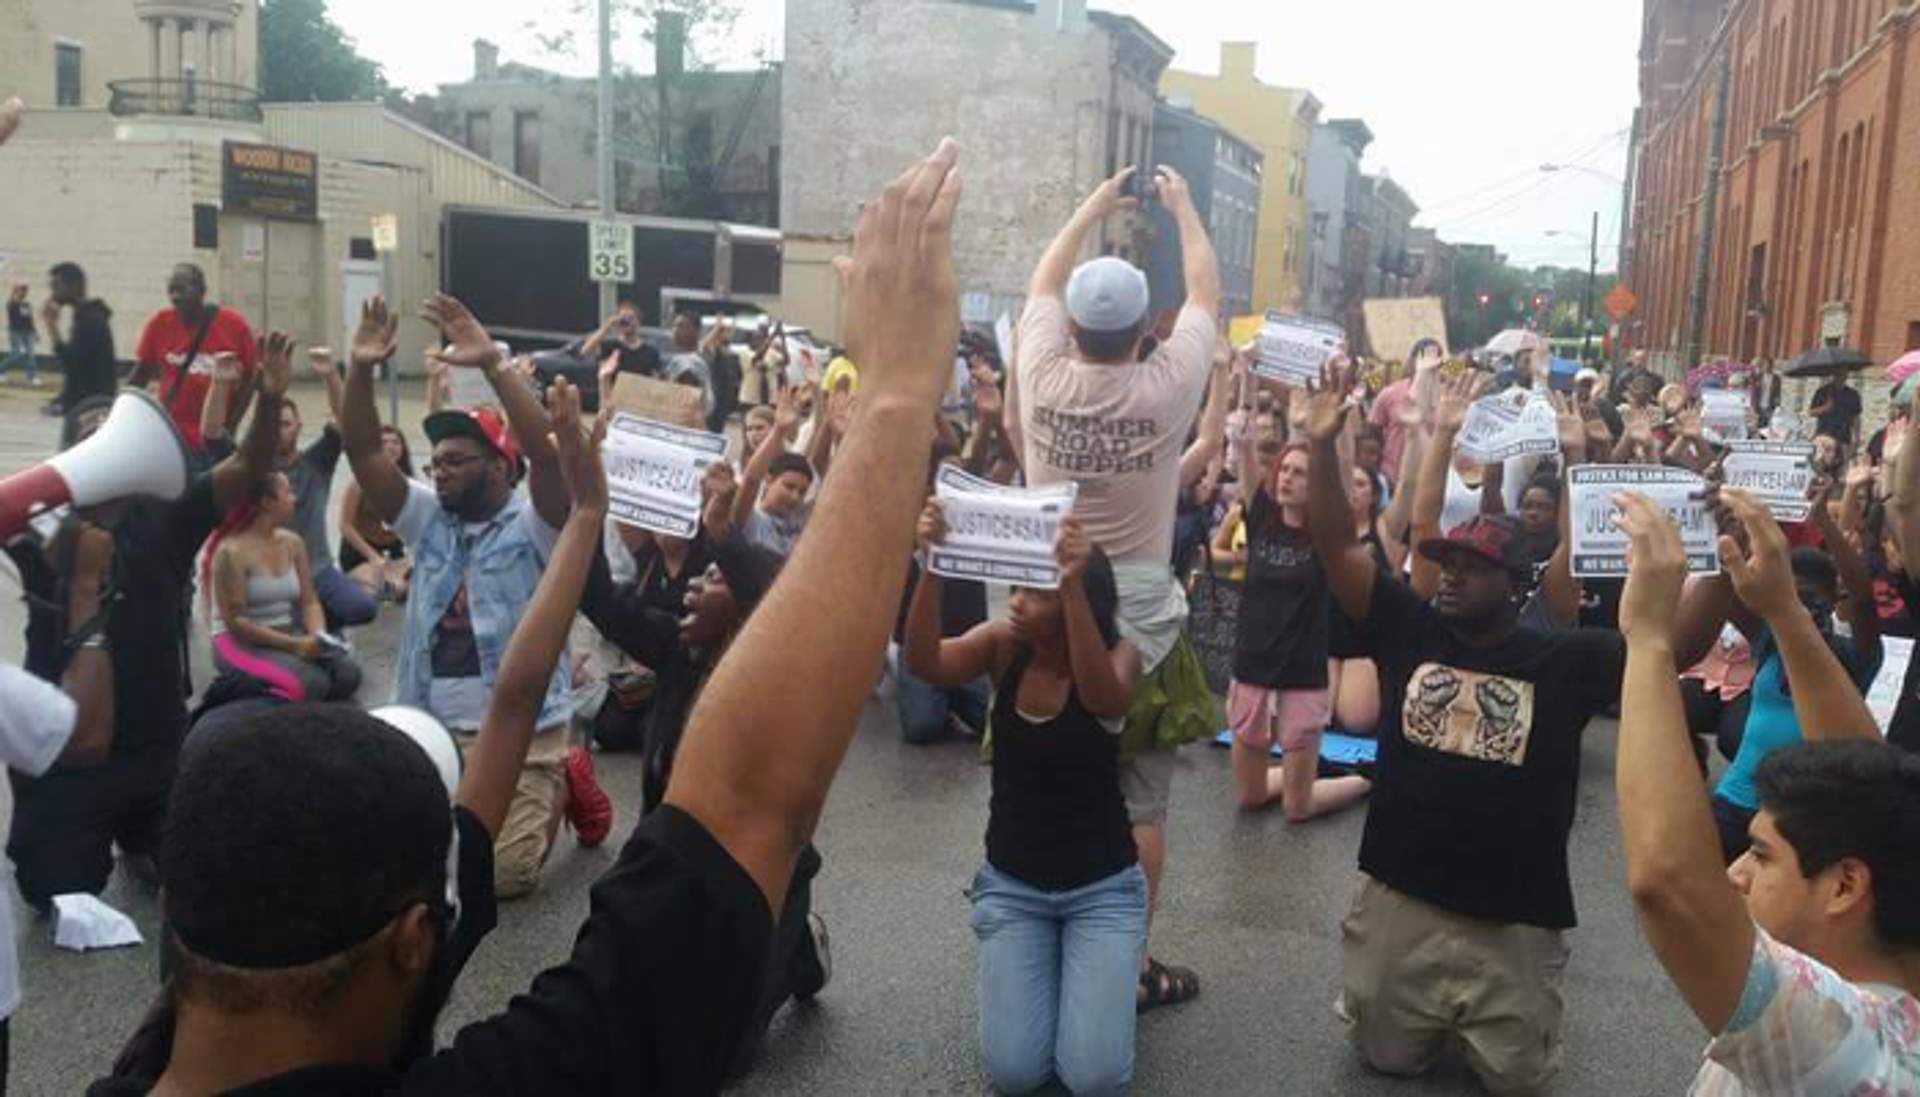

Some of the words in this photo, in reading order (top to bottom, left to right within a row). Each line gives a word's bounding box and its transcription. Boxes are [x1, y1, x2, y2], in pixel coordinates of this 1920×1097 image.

[595, 225, 627, 237] SPEED
[595, 252, 629, 277] 35
[1033, 406, 1157, 437] SUMMER
[1056, 432, 1131, 454] ROAD
[1036, 446, 1153, 474] TRIPPER
